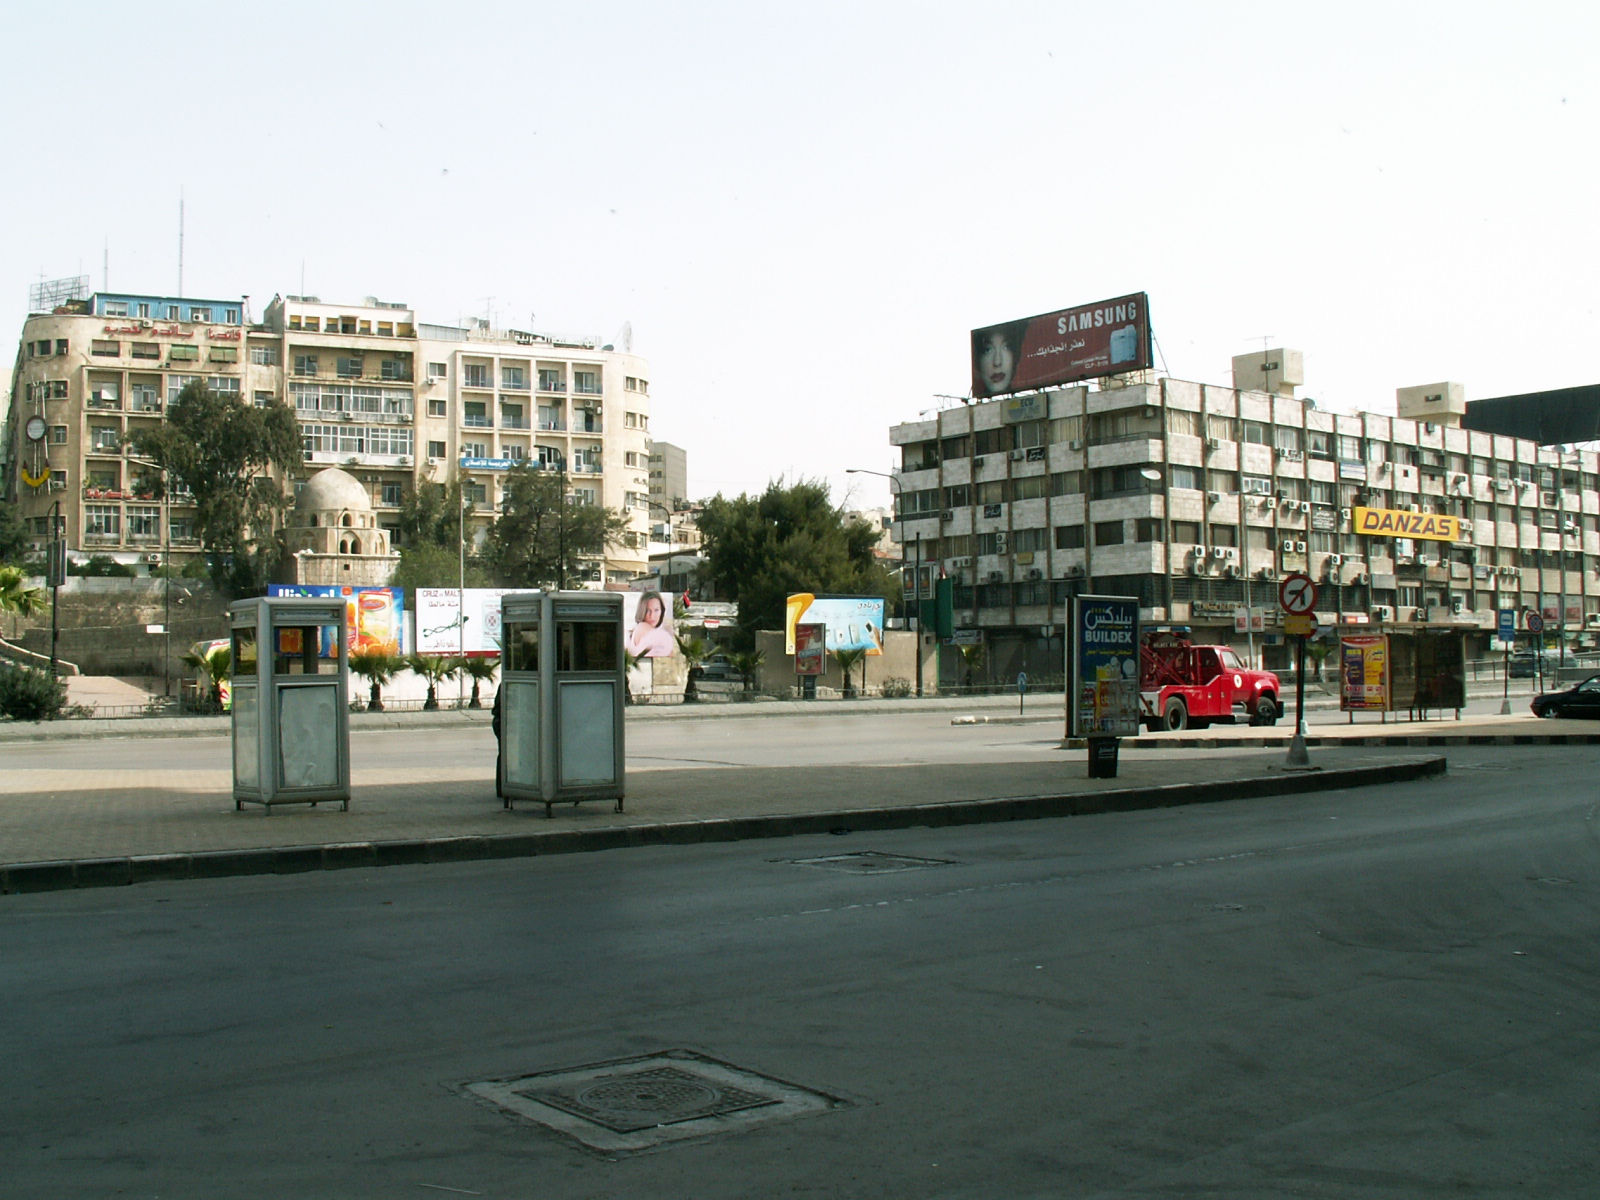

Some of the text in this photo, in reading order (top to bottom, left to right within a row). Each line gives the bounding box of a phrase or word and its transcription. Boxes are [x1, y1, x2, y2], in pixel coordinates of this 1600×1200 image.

[1057, 302, 1137, 335] SAMSUNG
[487, 459, 511, 468] العربية
[1363, 511, 1452, 536] DANZAS
[422, 590, 439, 598] CRUZ
[444, 590, 464, 598] MALT
[1085, 606, 1132, 630] بيلدكس
[1085, 631, 1132, 643] BUILDEX
